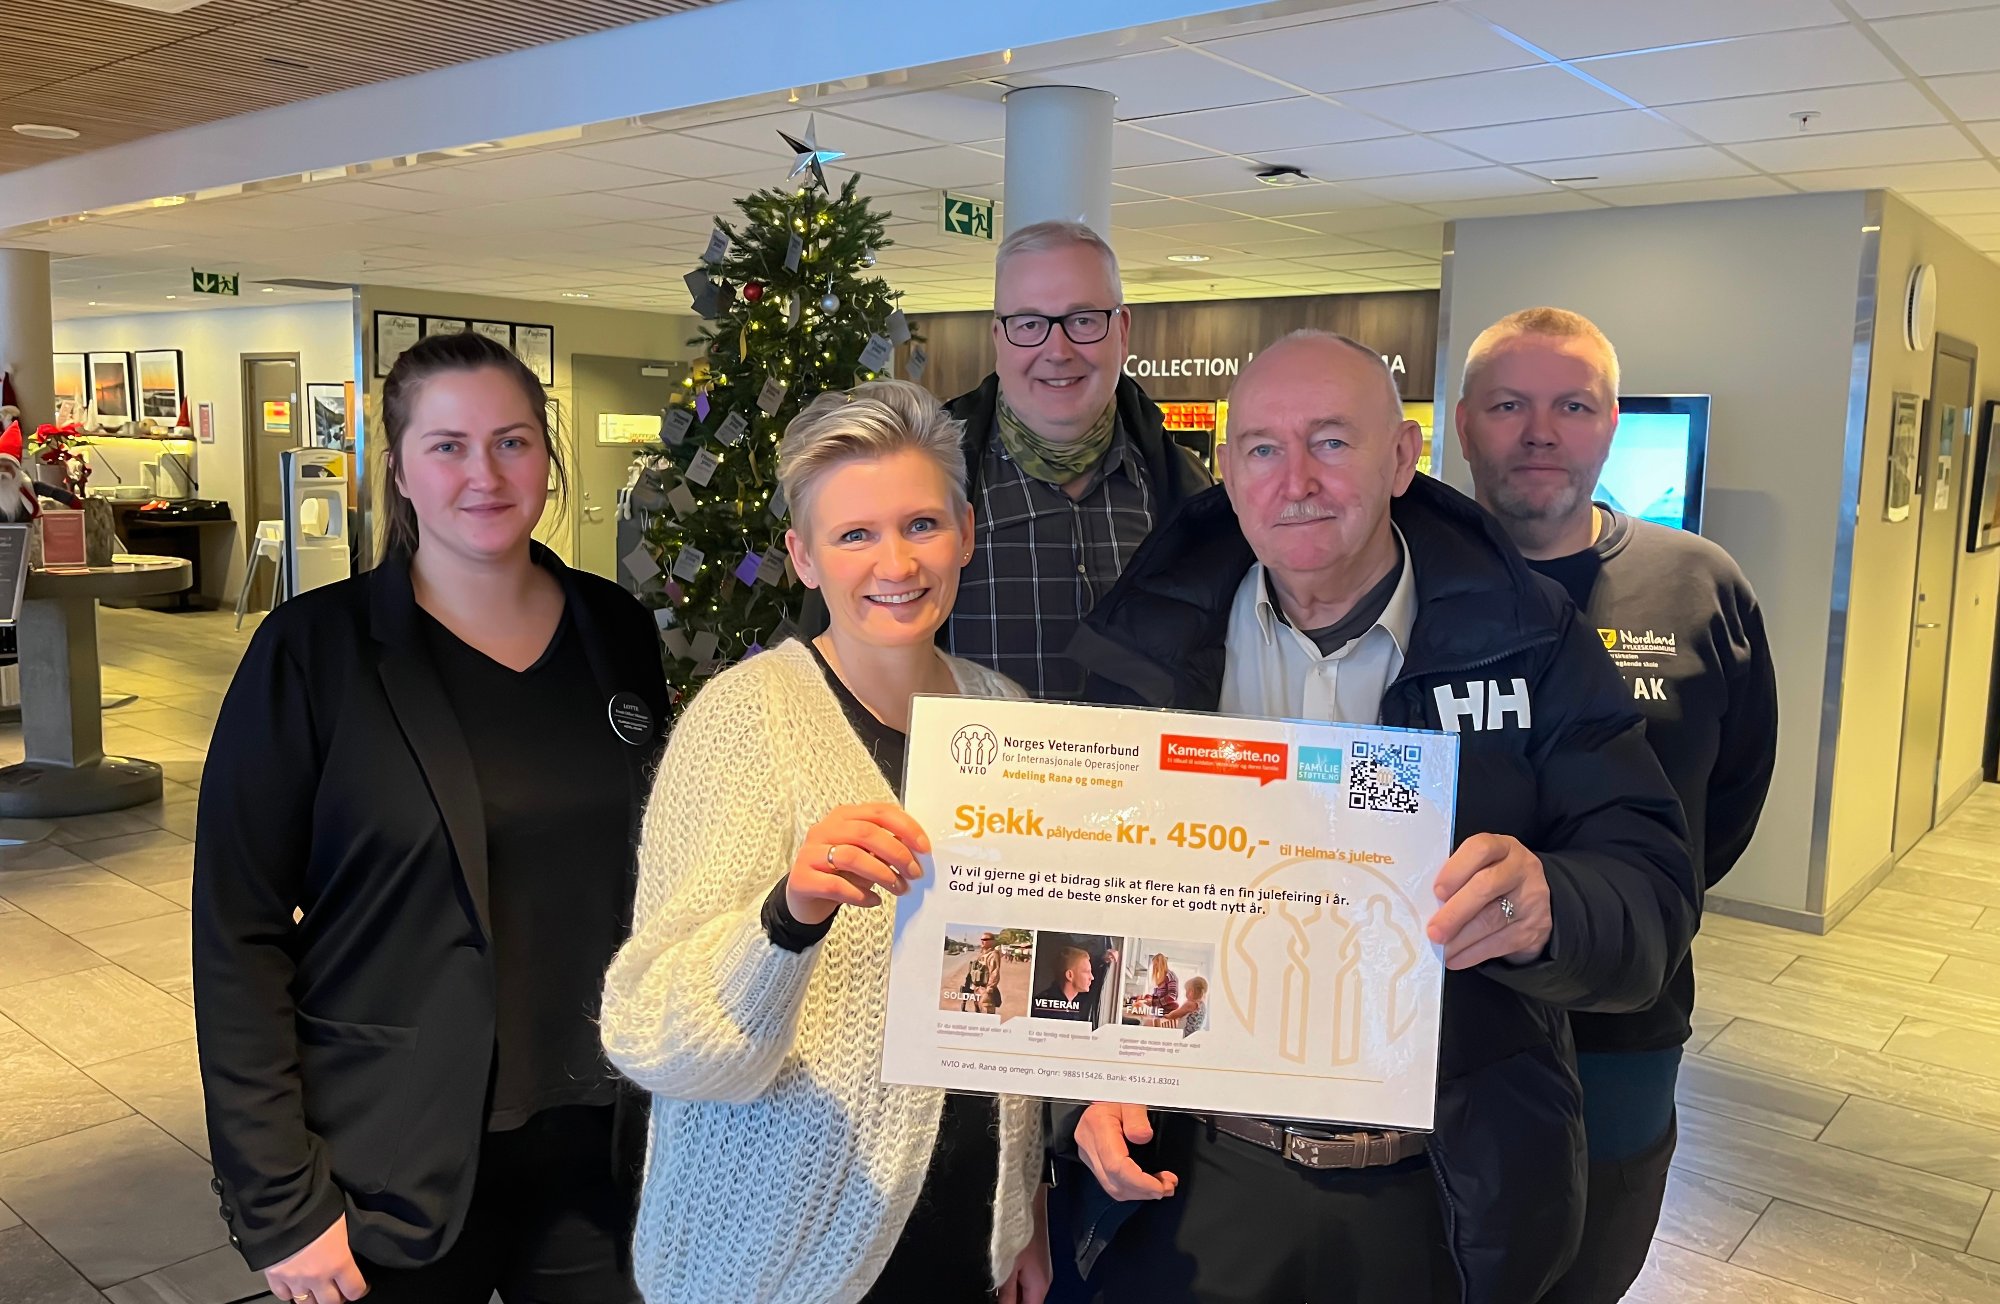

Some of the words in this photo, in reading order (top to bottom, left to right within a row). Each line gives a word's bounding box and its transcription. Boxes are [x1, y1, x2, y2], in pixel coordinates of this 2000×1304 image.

[1620, 629, 1675, 646] Nordland
[1433, 678, 1531, 732] HH
[1004, 736, 1044, 751] Norges
[1048, 740, 1139, 757] Veteranforbund
[960, 765, 987, 775] NVIO
[1002, 753, 1015, 762] for
[1017, 753, 1082, 767] Internasjonale
[1084, 758, 1139, 772] Operasjoner
[1002, 769, 1046, 783] Avdeling
[1049, 773, 1073, 784] Rana
[1075, 776, 1088, 787] og
[1090, 778, 1123, 788] omegn
[954, 804, 1044, 839] Sjekk
[1046, 826, 1113, 842] pålydende
[1116, 814, 1156, 845] kr.
[1167, 822, 1270, 858] 4500,-
[1279, 844, 1292, 856] til
[1348, 850, 1395, 865] juletre.
[950, 865, 962, 876] Vi
[966, 867, 980, 877] vil
[984, 869, 1025, 881] gjerne
[1029, 871, 1040, 883] gi
[1044, 873, 1057, 883] et
[1061, 873, 1100, 888] bidrag
[1104, 877, 1125, 889] slik
[1129, 880, 1142, 890] at
[1145, 880, 1173, 892] flere
[1178, 883, 1200, 894] kan
[1204, 883, 1215, 895] få
[1219, 887, 1234, 897] en
[1238, 886, 1254, 898] fin
[1257, 888, 1321, 906] julefeiring
[1325, 892, 1330, 904] i
[1332, 893, 1350, 906] år.
[949, 881, 974, 892] God
[976, 882, 994, 895] jul
[997, 886, 1013, 897] og
[1017, 886, 1044, 898] med
[1047, 887, 1063, 899] de
[1067, 889, 1101, 902] beste
[1105, 892, 1148, 906] ønsker
[1151, 895, 1169, 907] for
[1172, 898, 1185, 908] et
[1188, 899, 1217, 912] godt
[1220, 902, 1246, 915] nytt
[1249, 902, 1266, 915] år.
[943, 991, 981, 1002] SOLDAT
[1035, 998, 1080, 1010] VETERAN
[1125, 1005, 1164, 1017] FAMILIE
[941, 1060, 960, 1068] NVIO
[961, 1062, 976, 1070] avd.
[979, 1063, 997, 1071] Rana
[998, 1065, 1008, 1073] og
[1009, 1067, 1035, 1075] omegn.
[1037, 1068, 1060, 1077] Orgnr:
[1106, 1074, 1127, 1082] Bank:
